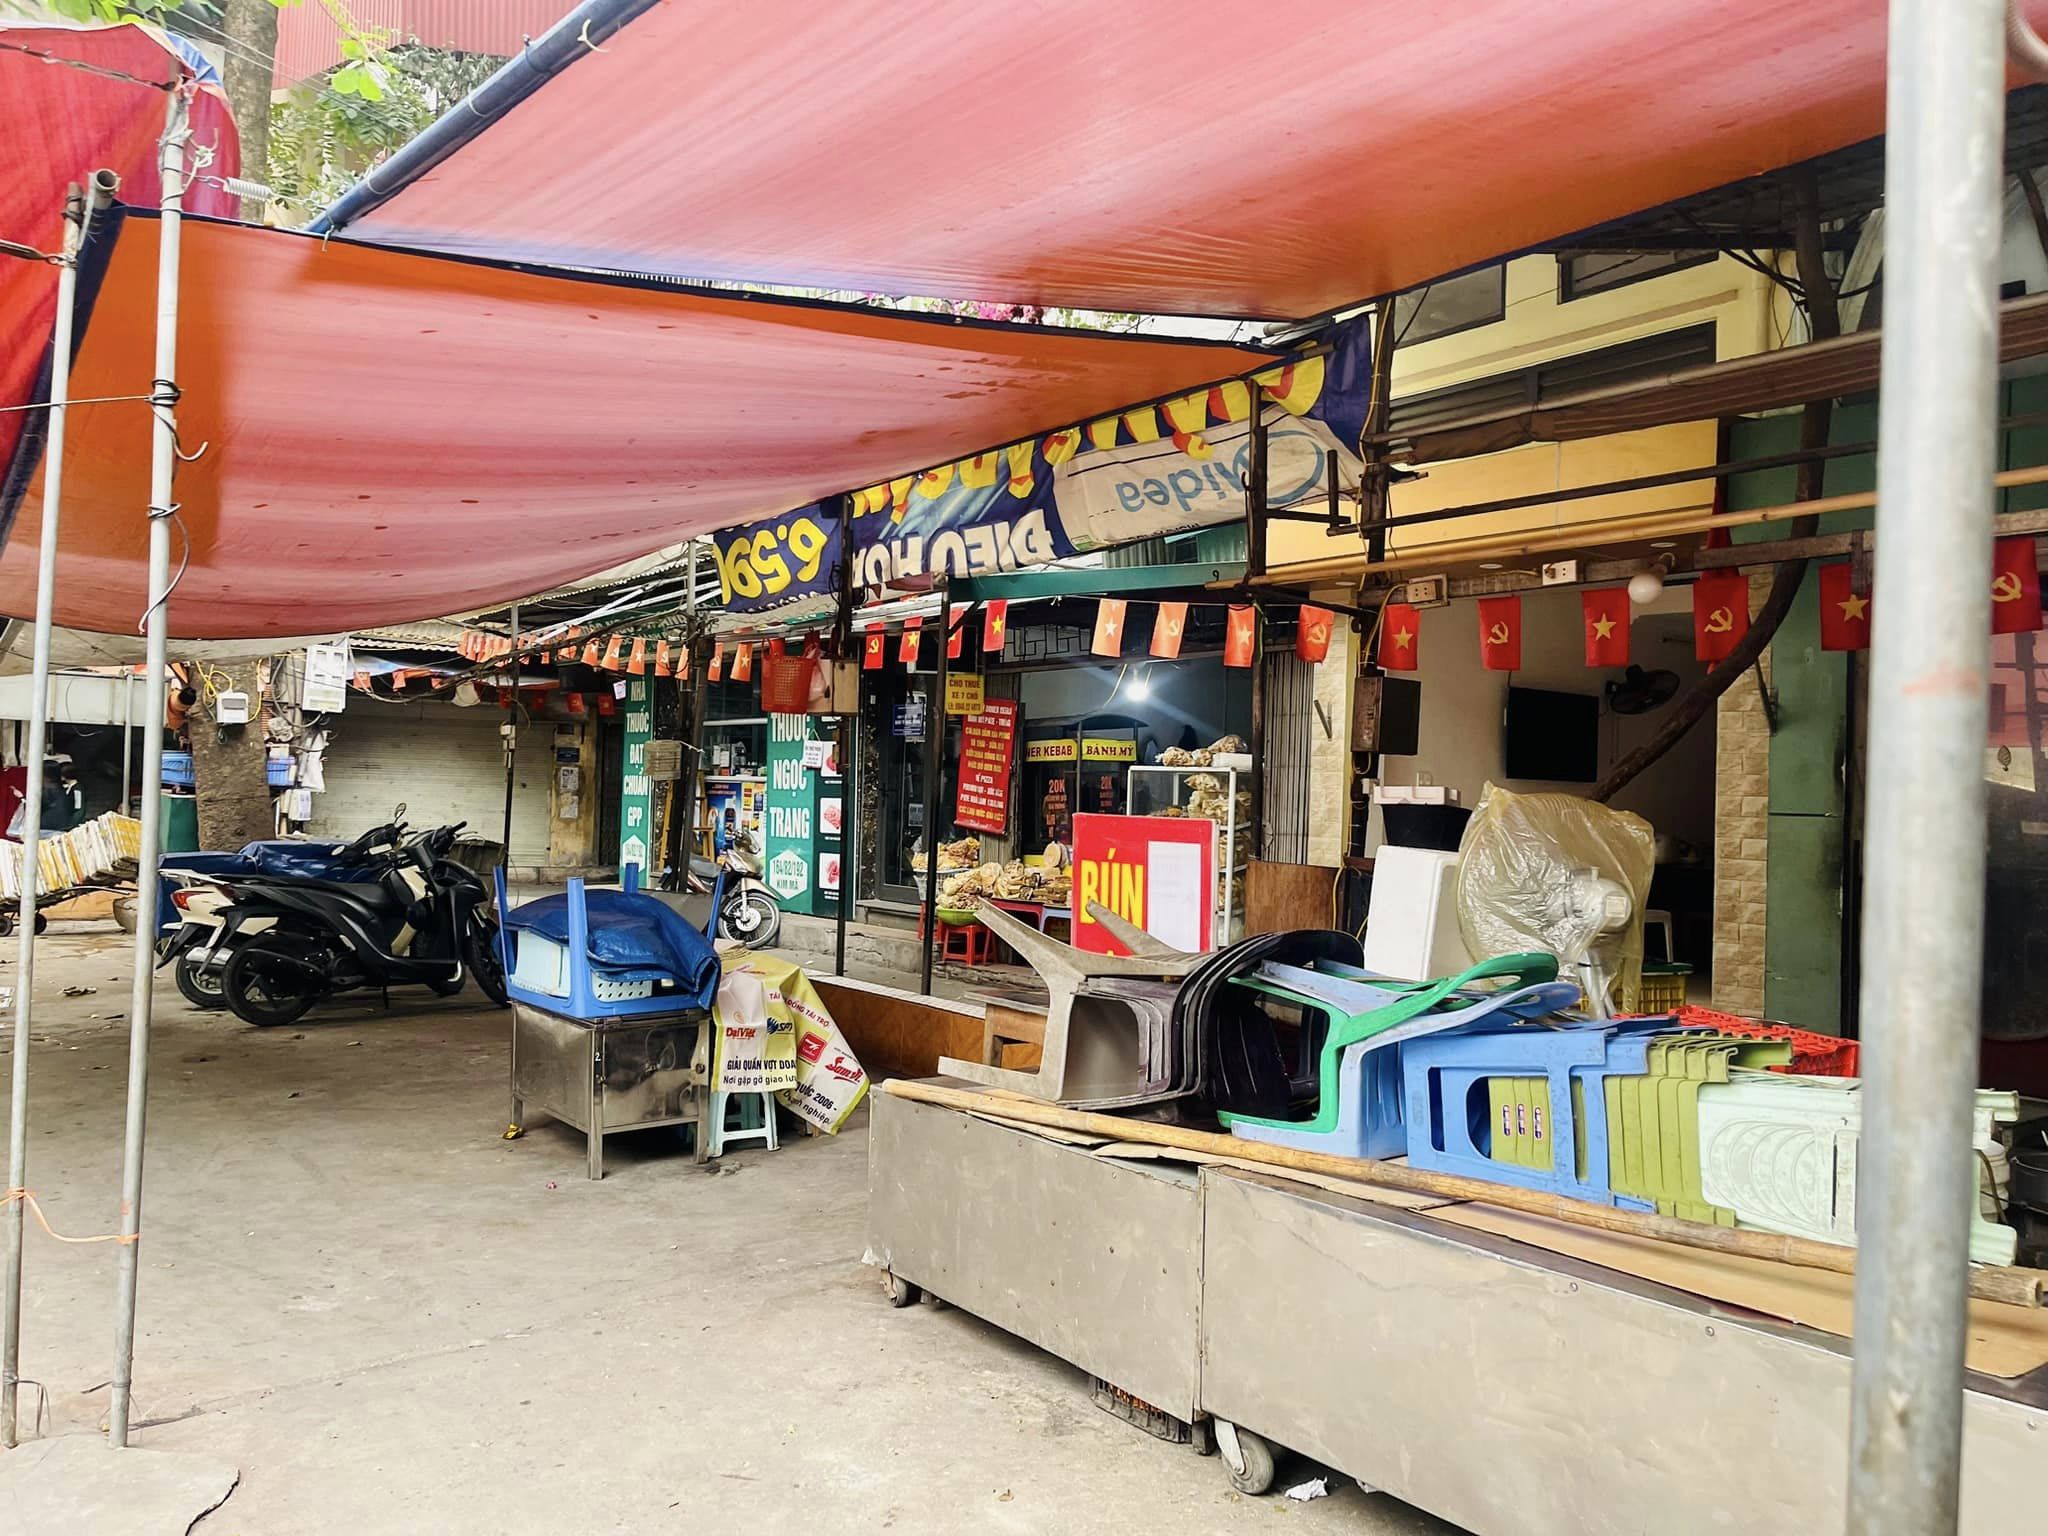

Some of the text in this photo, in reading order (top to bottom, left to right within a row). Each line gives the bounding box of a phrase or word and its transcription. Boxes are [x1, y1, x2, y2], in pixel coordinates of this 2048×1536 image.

[1043, 745, 1073, 757] KEBAB
[1086, 743, 1117, 756] BÁNH
[773, 758, 807, 797] NGỌC
[1048, 779, 1065, 793] 20K
[627, 806, 643, 827] GPP
[769, 806, 810, 839] TRANG
[1080, 847, 1144, 930] BÚN
[765, 1076, 783, 1086] giao
[813, 1093, 834, 1111] 2006
[802, 1103, 830, 1124] nghiệp
